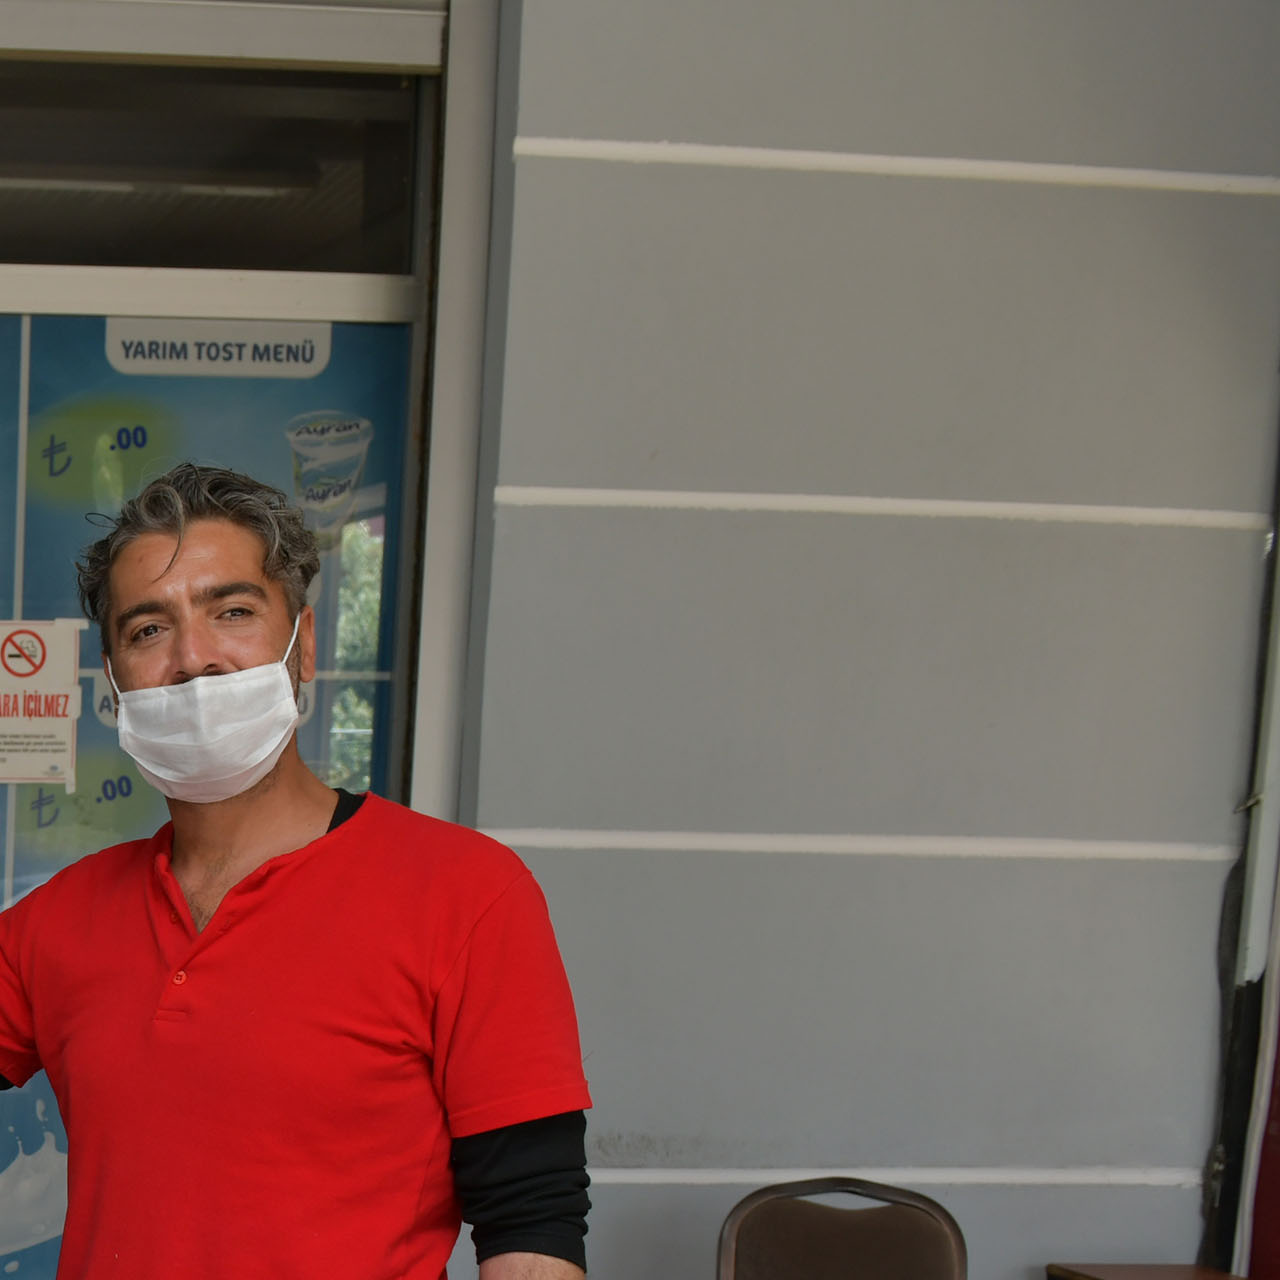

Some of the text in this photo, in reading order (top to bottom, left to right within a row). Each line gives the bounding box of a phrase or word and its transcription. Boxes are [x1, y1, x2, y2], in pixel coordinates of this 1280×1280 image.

[121, 340, 315, 363] YARIM TOST MENÜ
[23, 690, 70, 720] İÇİLMEZ
